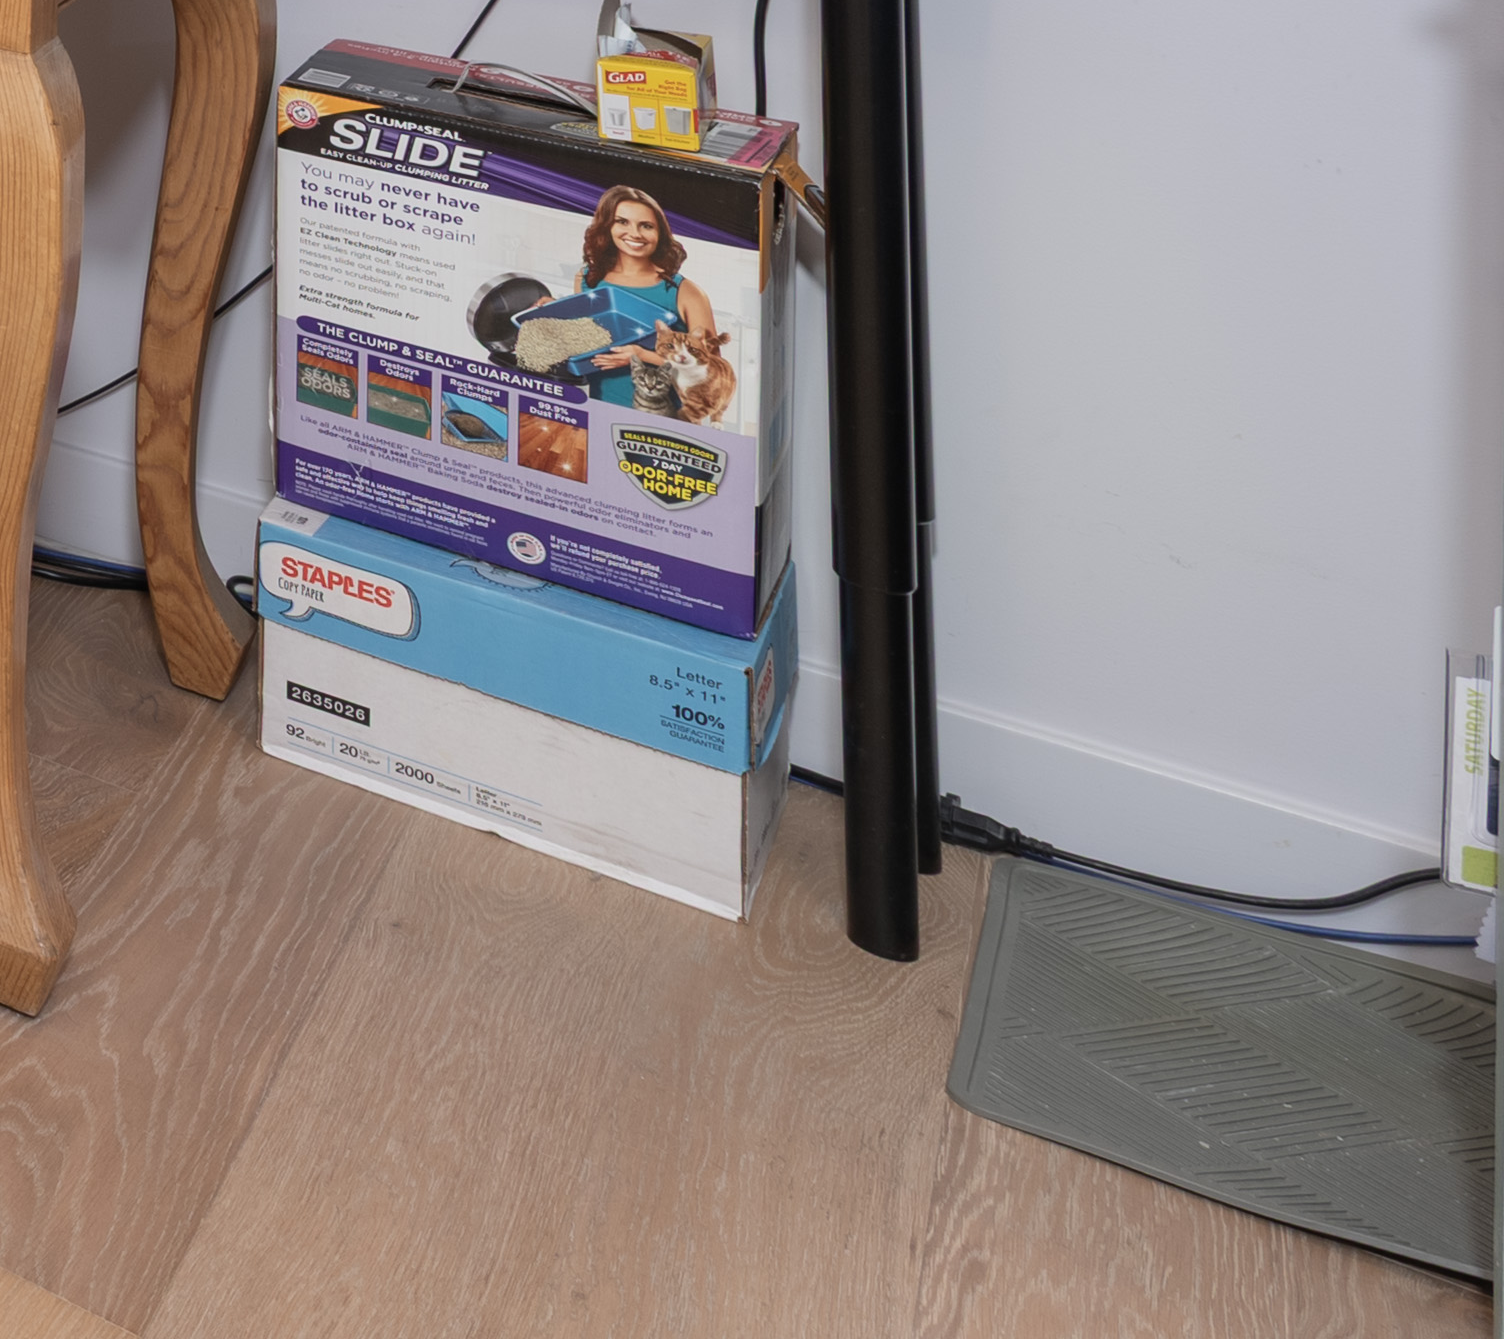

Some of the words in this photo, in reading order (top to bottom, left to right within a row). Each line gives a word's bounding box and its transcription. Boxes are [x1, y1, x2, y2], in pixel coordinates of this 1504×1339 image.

[608, 72, 644, 83] GLAD
[365, 113, 464, 142] CLUMP&SEAL
[329, 118, 484, 177] SLIDE
[320, 147, 345, 159] EASY
[346, 153, 393, 169] CLEAN-UP
[394, 163, 450, 181] CLUMPING
[452, 174, 489, 190] LITTER
[300, 179, 319, 191] to
[324, 182, 373, 205] scrub
[377, 197, 398, 210] or
[402, 204, 464, 226] scrape
[301, 161, 333, 180] You
[338, 172, 375, 190] may
[381, 182, 431, 201] never
[437, 193, 480, 213] have
[300, 195, 329, 211] the
[334, 202, 377, 222] litter
[382, 213, 415, 232] box
[422, 223, 476, 246] again!
[318, 323, 344, 339] THE
[349, 331, 398, 352] CLUMP
[402, 345, 412, 357] &
[466, 363, 564, 397] GUARANTEE
[617, 440, 722, 473] GUARANTEED
[661, 461, 683, 473] DAY
[618, 460, 717, 496] ODOR-FREE
[643, 478, 693, 501] HOME
[278, 577, 298, 596] COPY
[300, 584, 325, 603] PAPER
[281, 556, 393, 609] STAPLES
[676, 666, 723, 690] Letter
[291, 686, 367, 721] 2635026
[671, 704, 725, 731] 100%
[285, 724, 305, 741] 92
[1465, 687, 1486, 776] SATURDAY
[339, 742, 358, 759] 20
[395, 762, 434, 785] 2000
